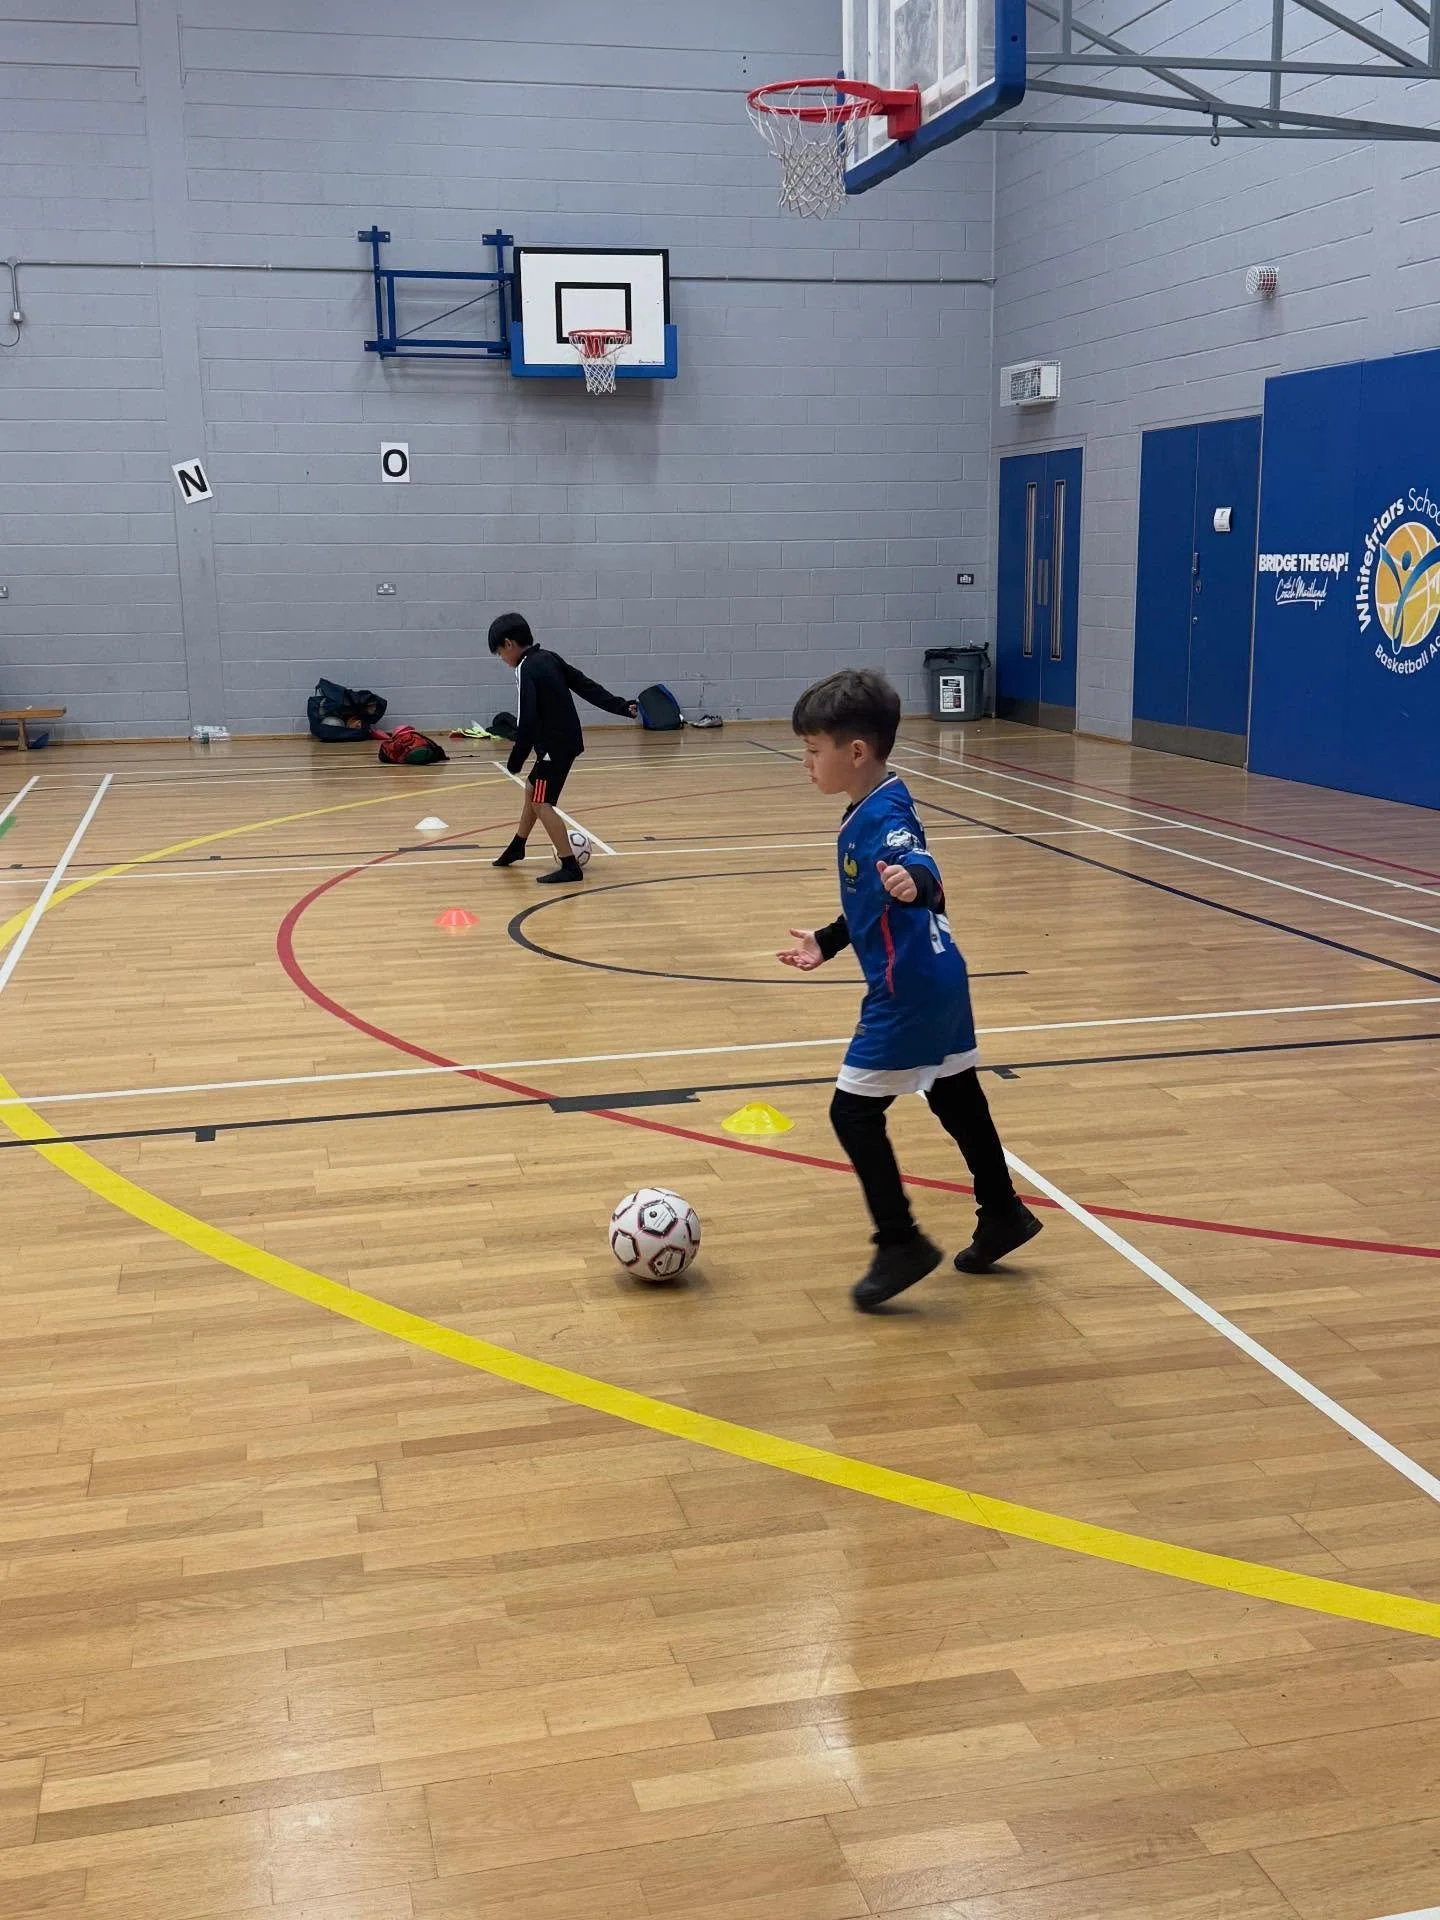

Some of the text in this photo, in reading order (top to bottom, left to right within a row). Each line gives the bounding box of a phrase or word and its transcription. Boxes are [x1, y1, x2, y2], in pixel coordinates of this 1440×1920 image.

[382, 448, 408, 477] O
[177, 465, 208, 498] N
[1258, 552, 1349, 577] BRIDGE THE GAP!
[1355, 498, 1405, 633] Whitefriars
[1374, 643, 1429, 675] Basketball
